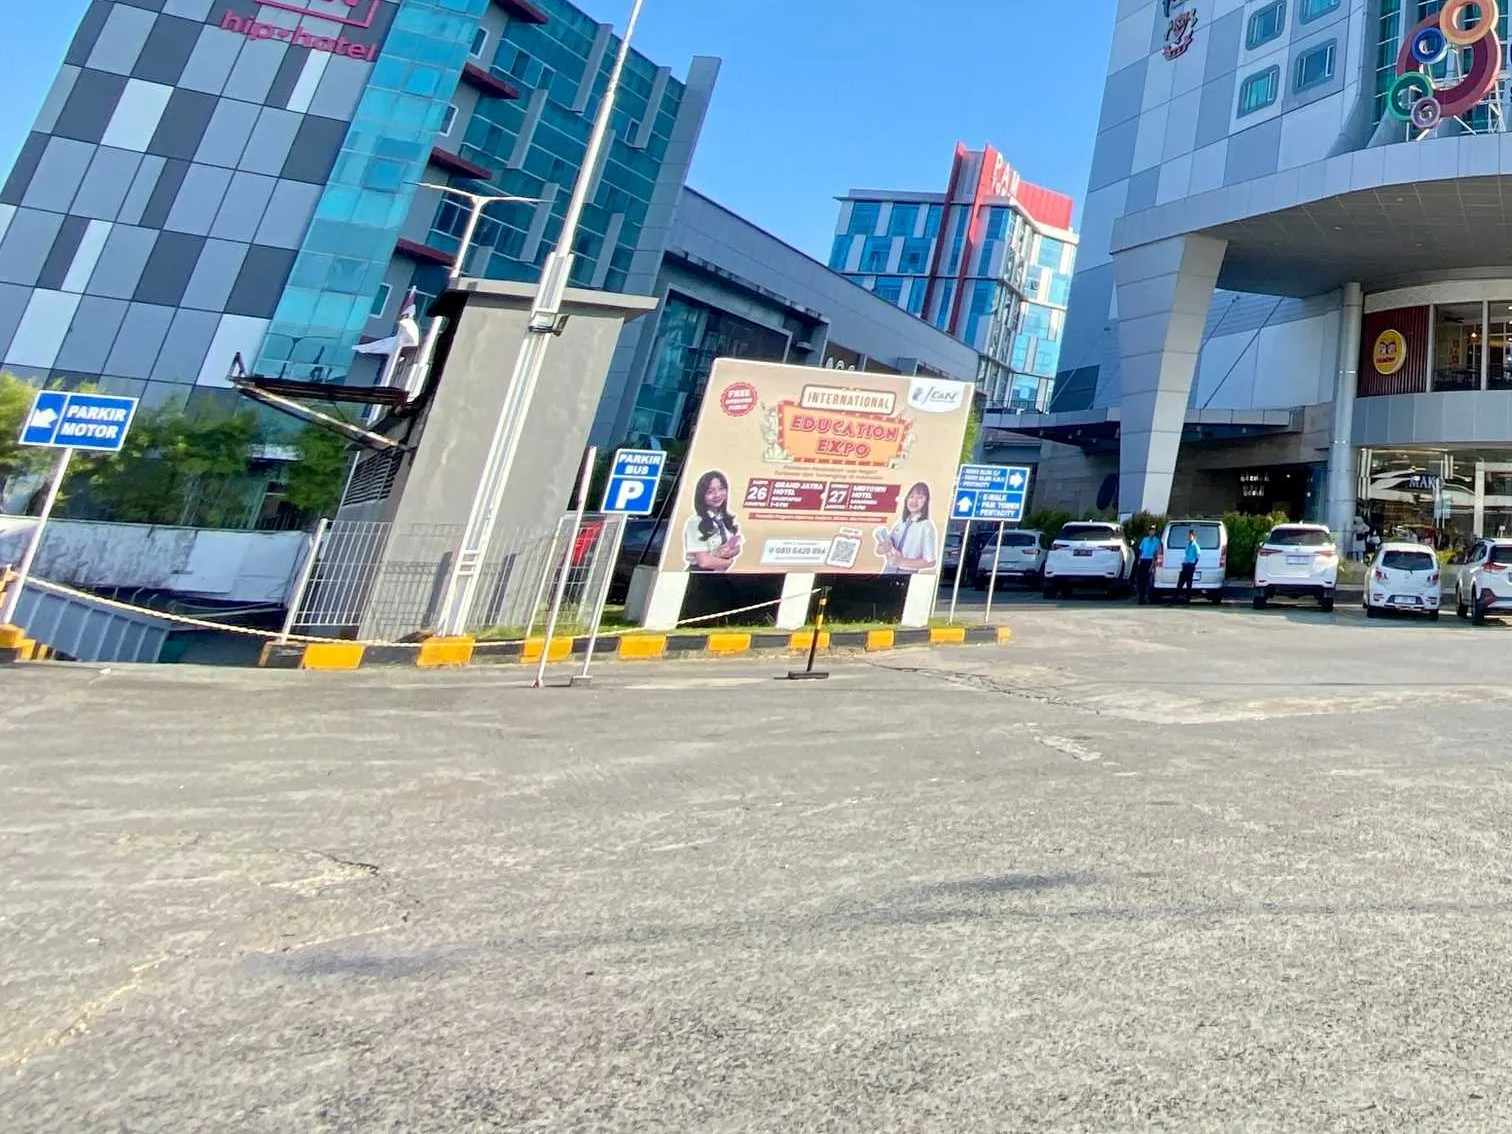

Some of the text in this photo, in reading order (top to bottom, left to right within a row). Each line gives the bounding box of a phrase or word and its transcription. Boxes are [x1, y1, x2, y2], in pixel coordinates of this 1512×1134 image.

[993, 152, 1020, 197] PAM
[807, 392, 890, 409] INTERNATIONAL
[66, 405, 127, 422] PARKIR
[60, 422, 119, 439] MOTOR
[790, 414, 899, 442] EDUCATION
[816, 438, 871, 459] EXPO
[619, 454, 661, 465] PARKIR
[624, 465, 649, 475] BUS
[615, 480, 645, 509] P
[746, 486, 767, 500] 26
[772, 488, 796, 496] HOTEL
[828, 490, 847, 504] 27
